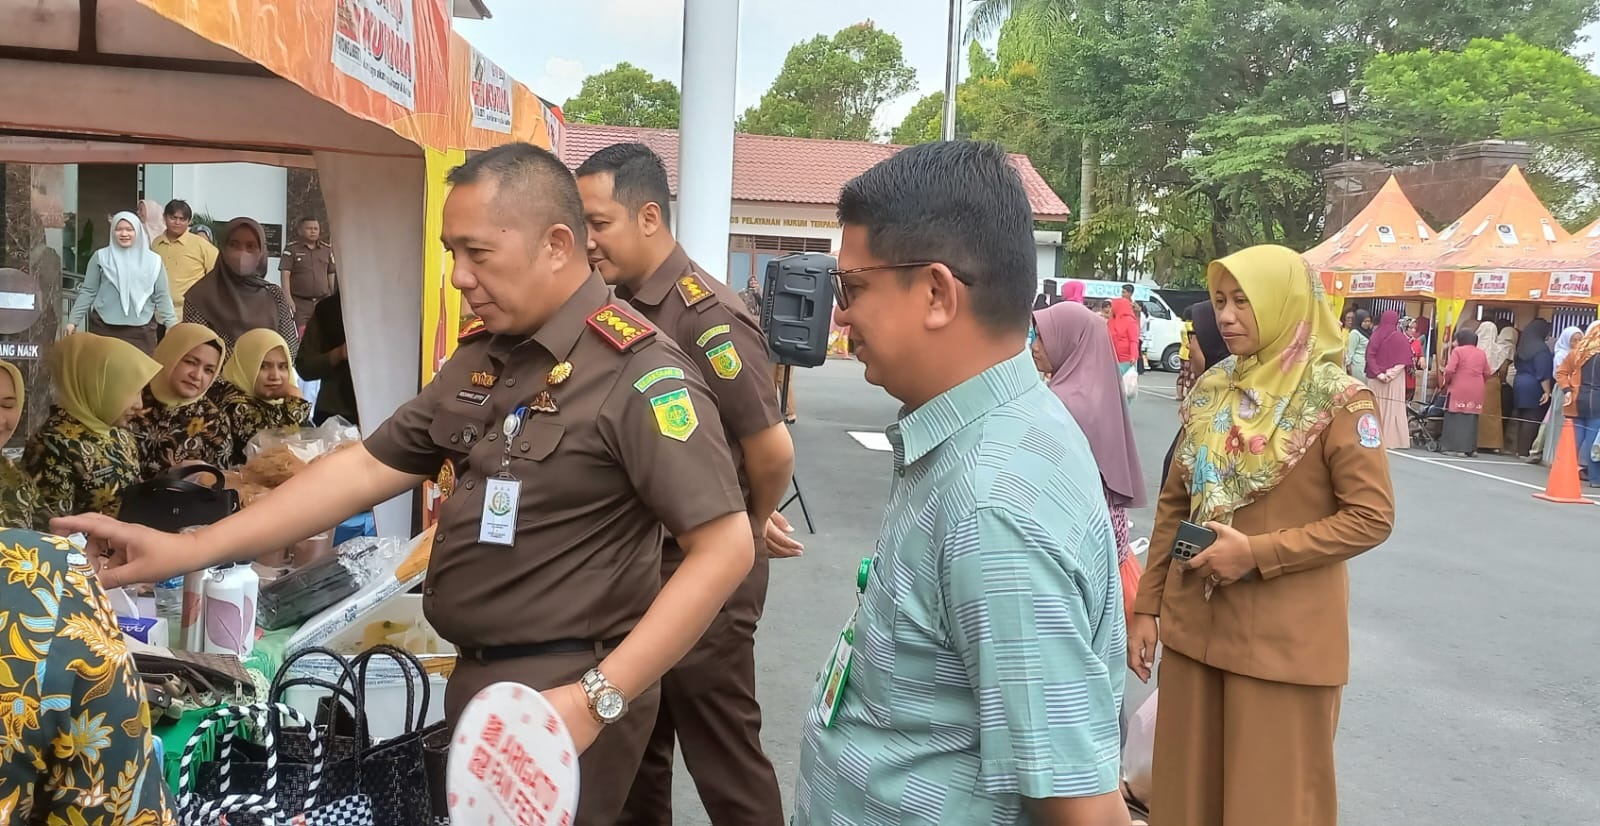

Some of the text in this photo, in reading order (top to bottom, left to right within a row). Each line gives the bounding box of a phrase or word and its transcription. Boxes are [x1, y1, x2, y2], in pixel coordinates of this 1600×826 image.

[730, 216, 739, 225] OS
[741, 216, 780, 226] PELAYANAN
[783, 219, 808, 228] HUKUM
